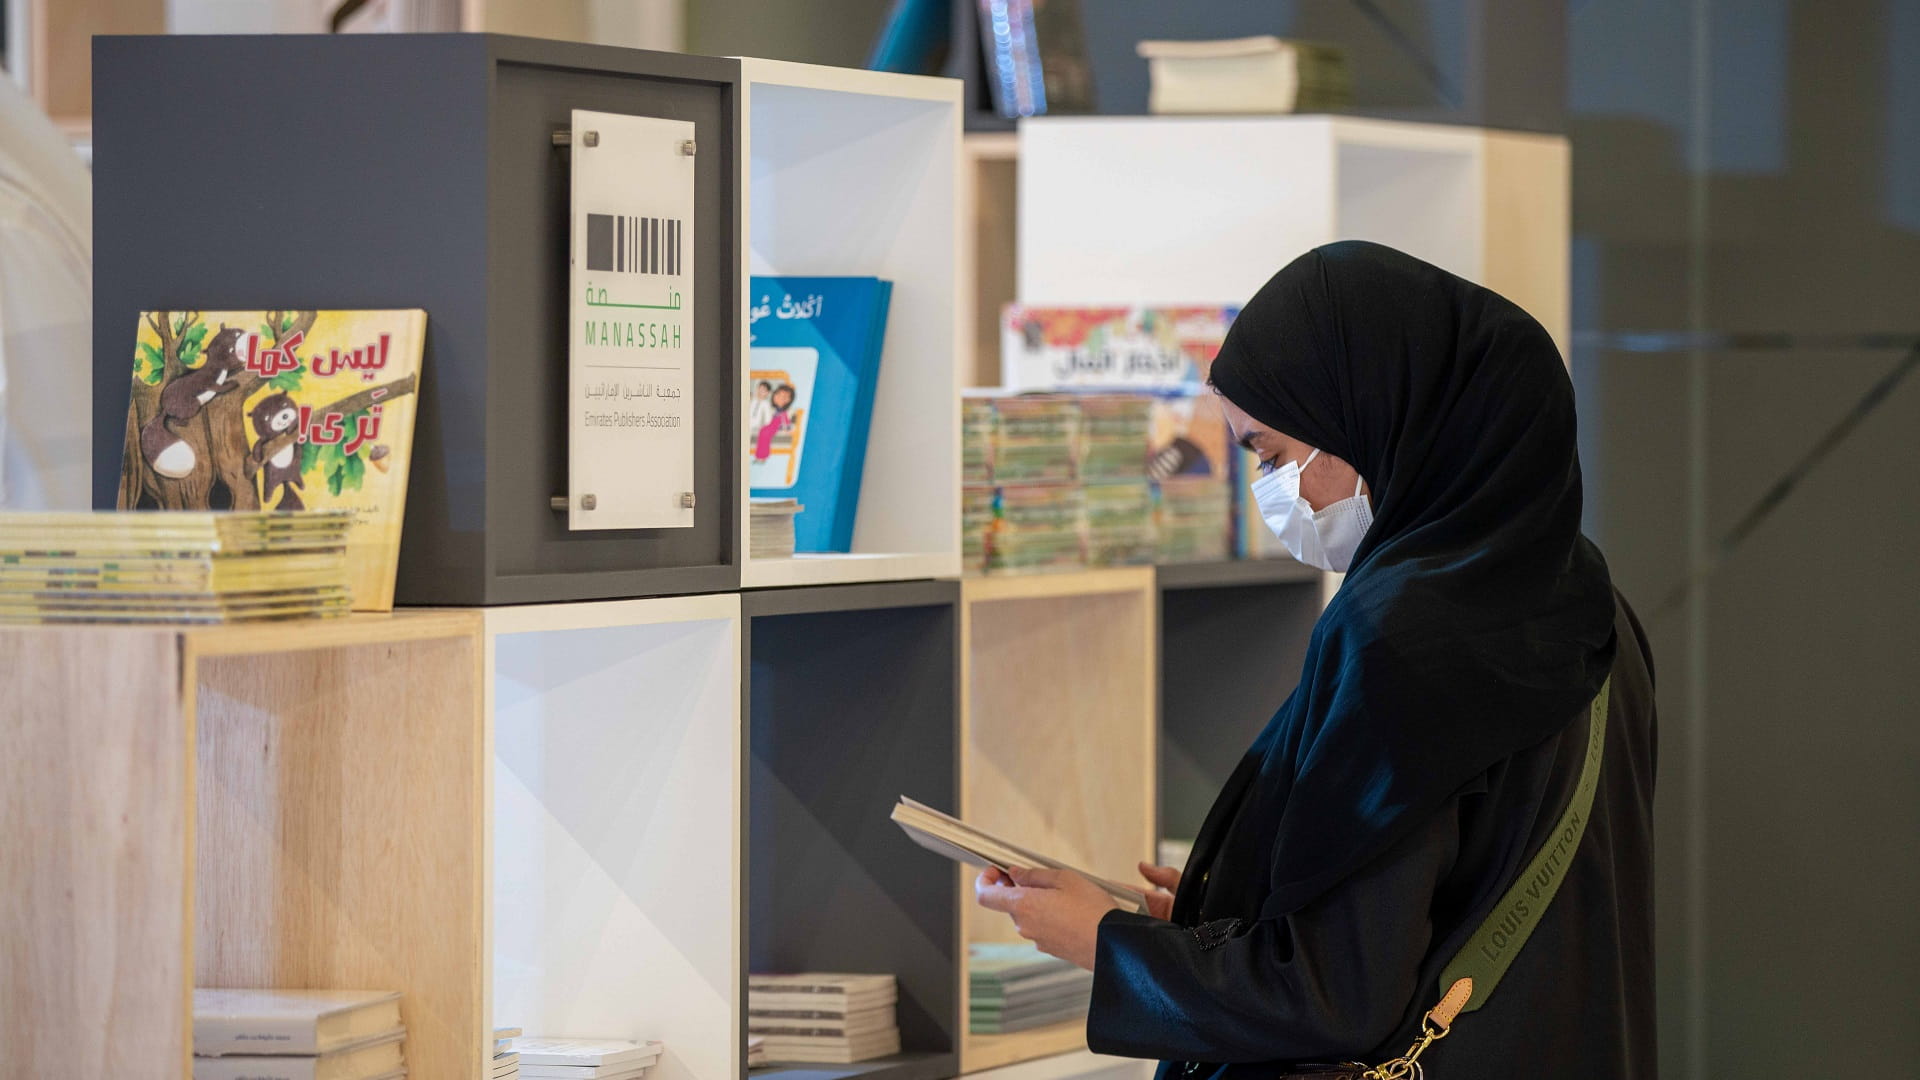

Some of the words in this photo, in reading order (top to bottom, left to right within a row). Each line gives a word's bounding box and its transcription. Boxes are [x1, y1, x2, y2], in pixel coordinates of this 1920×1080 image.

[586, 280, 680, 310] منصة
[585, 320, 681, 349] MANASSAH
[246, 330, 304, 377] كما
[311, 333, 390, 380] ليس
[622, 383, 653, 401] الناشرين
[656, 384, 681, 402] جمعية
[584, 410, 613, 427] Emirates
[613, 410, 646, 428] Publishers
[646, 412, 681, 428] Association
[1481, 900, 1529, 962] LOUIS
[1526, 811, 1581, 899] VUITTON
